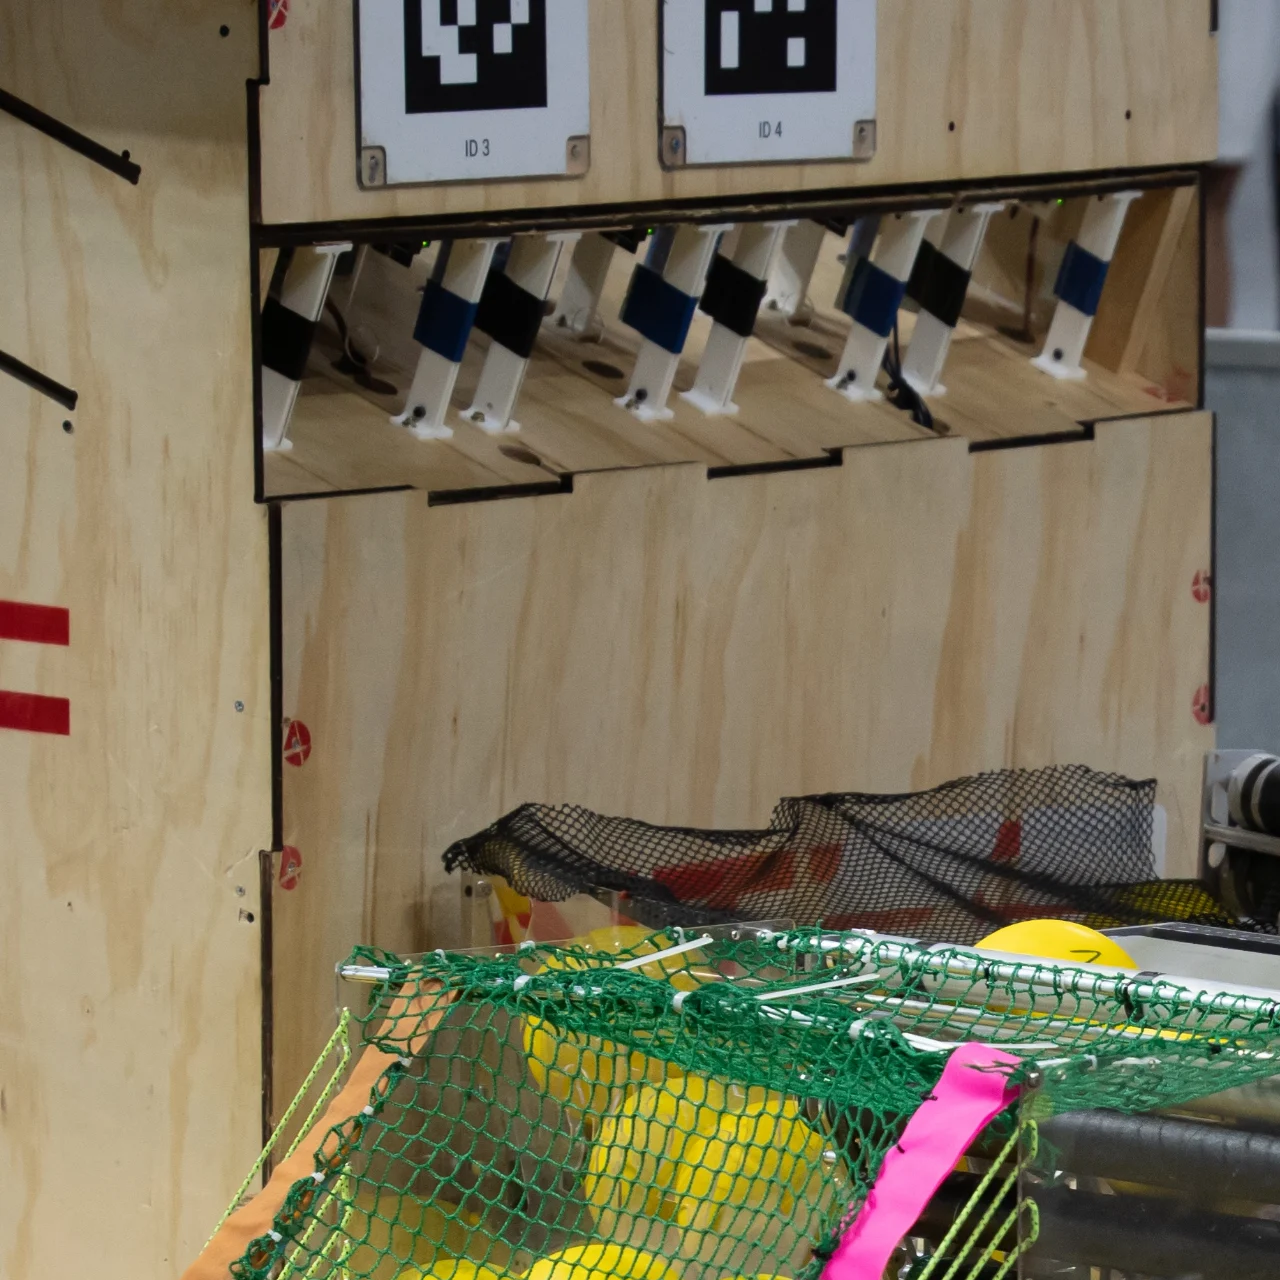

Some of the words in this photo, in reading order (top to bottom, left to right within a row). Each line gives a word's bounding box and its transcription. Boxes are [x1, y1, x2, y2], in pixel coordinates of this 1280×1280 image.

[759, 120, 771, 138] ID
[775, 120, 782, 138] 4
[465, 139, 478, 157] ID
[482, 138, 490, 156] 3
